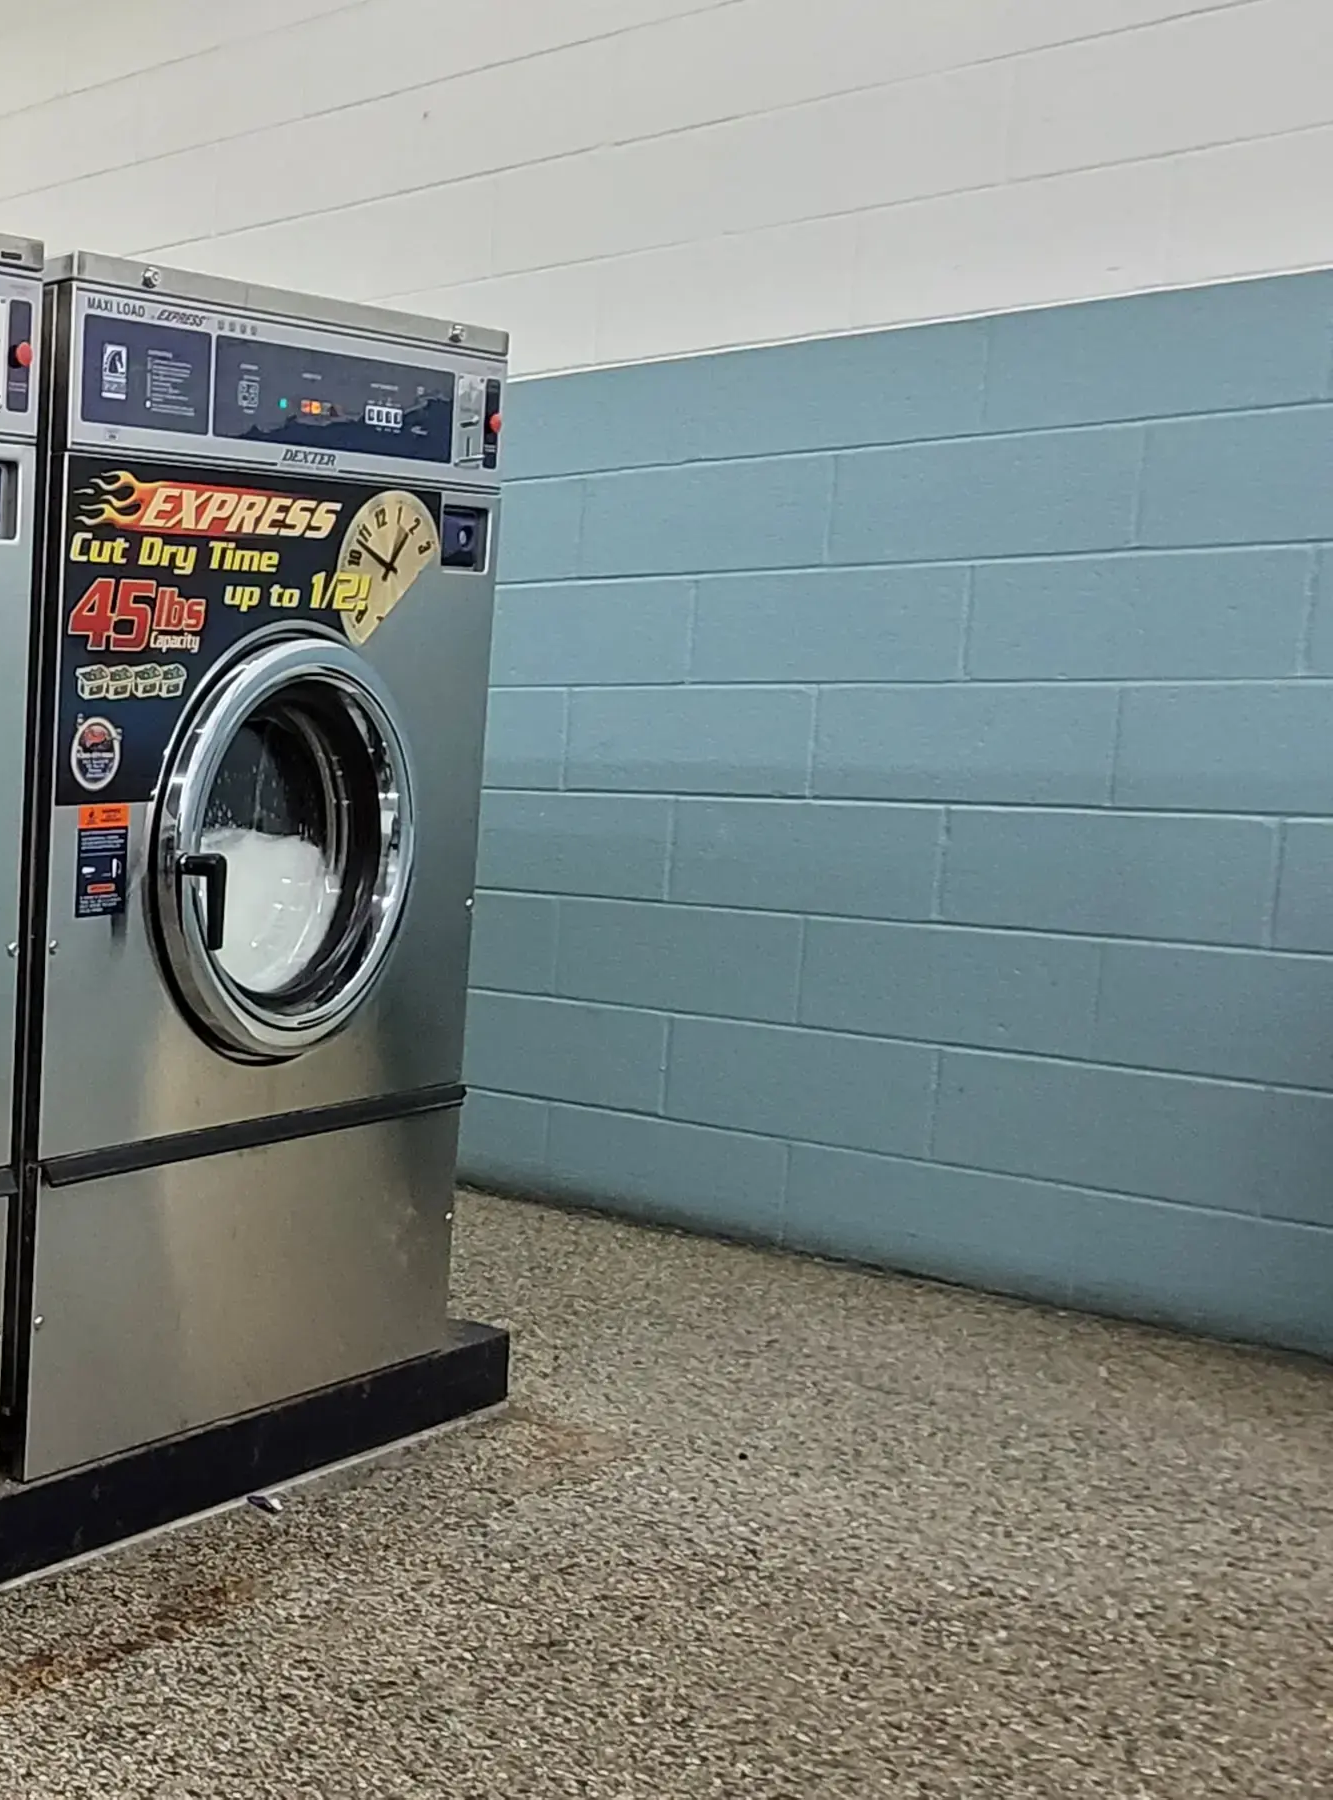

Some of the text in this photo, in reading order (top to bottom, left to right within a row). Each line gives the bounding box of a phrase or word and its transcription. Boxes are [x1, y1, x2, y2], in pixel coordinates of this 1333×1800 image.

[87, 297, 145, 318] MAXI LOAD
[156, 309, 206, 328] EXPRESS
[282, 449, 337, 466] DEXTER
[140, 487, 342, 540] EXPRESS
[374, 507, 388, 529] 12
[408, 517, 421, 536] 2
[69, 532, 280, 575] Cut Dry Time
[347, 549, 363, 567] 10
[224, 571, 372, 612] up to 1/2!
[68, 577, 206, 652] 45 lbs
[150, 630, 200, 655] Capacity
